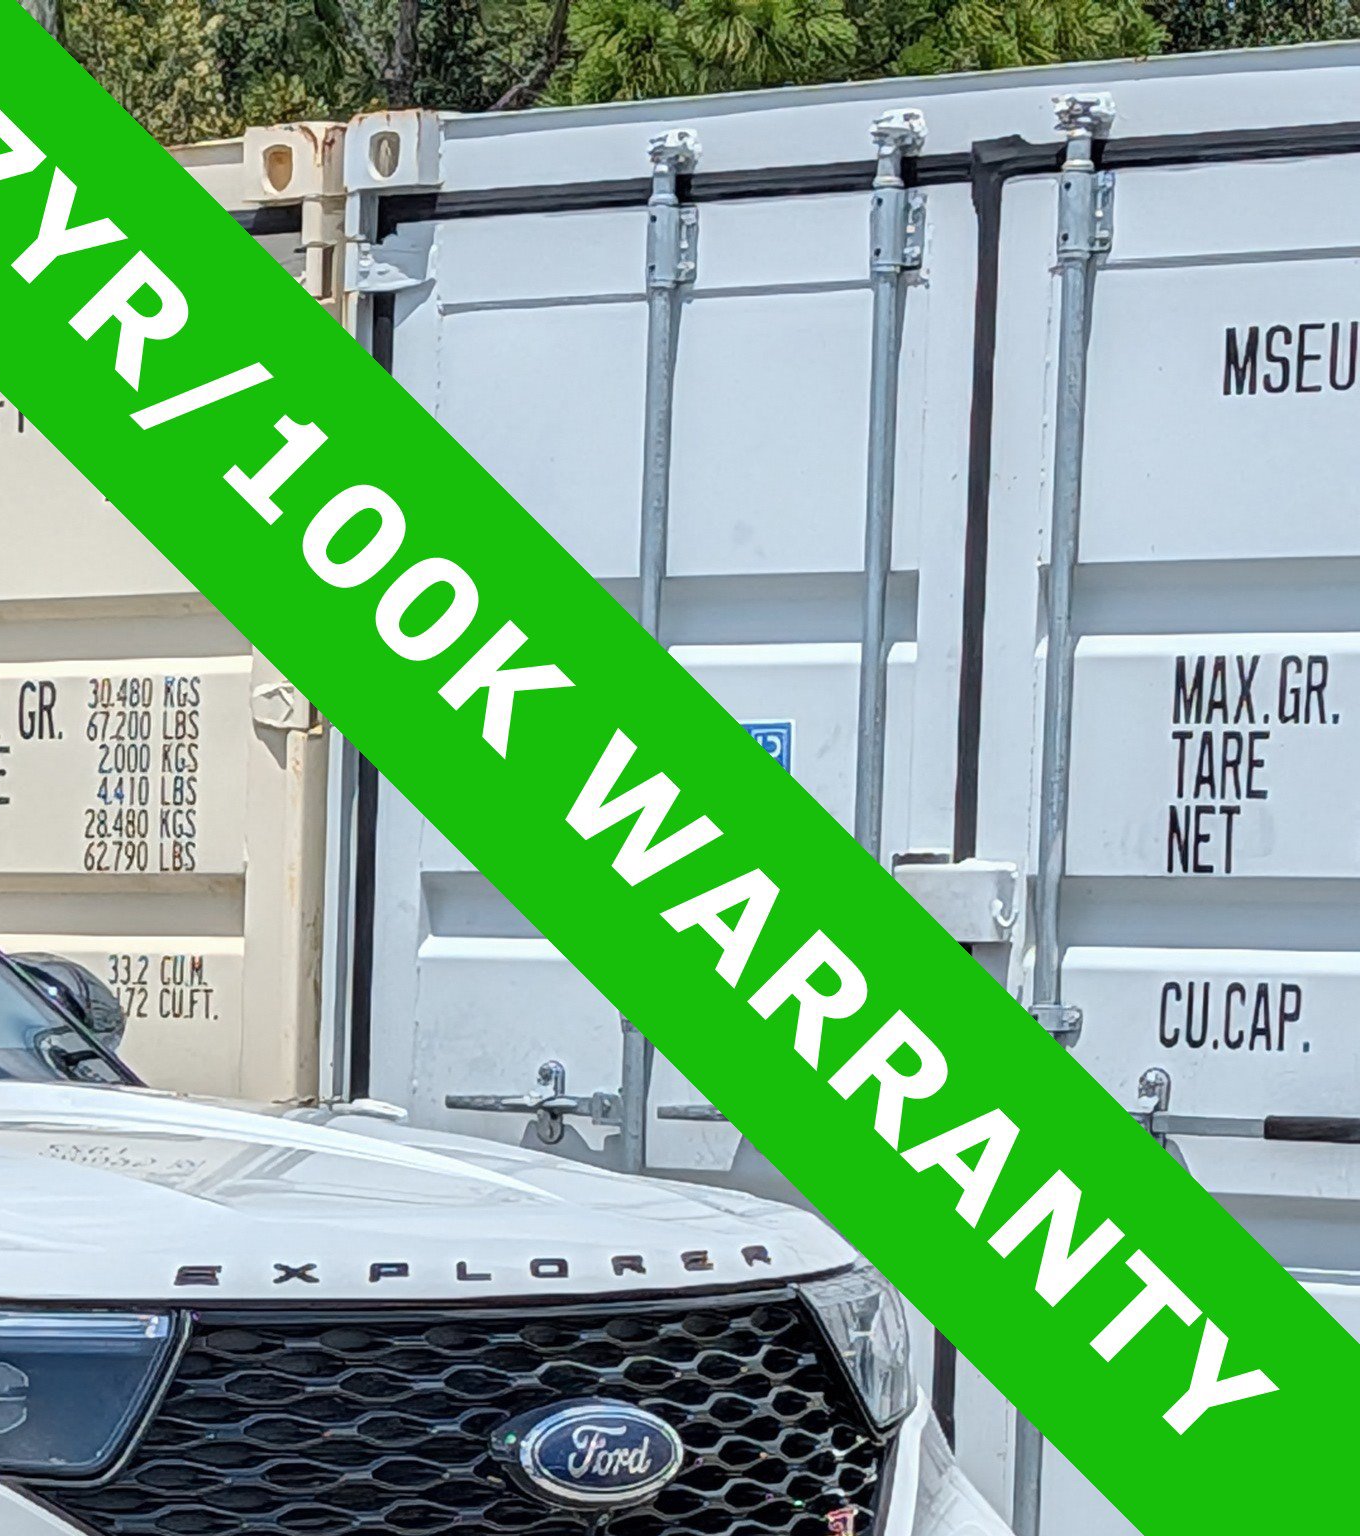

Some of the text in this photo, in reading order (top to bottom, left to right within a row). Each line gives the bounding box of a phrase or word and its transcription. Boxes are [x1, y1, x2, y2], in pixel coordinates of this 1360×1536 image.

[1223, 321, 1359, 395] MSEU
[18, 681, 63, 740] GR.
[163, 676, 201, 707] KGS
[162, 710, 199, 740] LBS
[161, 743, 198, 773] KGS
[1171, 731, 1270, 800] TARE
[160, 775, 197, 806] LBS
[159, 808, 196, 838] KGS
[1167, 805, 1241, 874] NET
[159, 840, 196, 871] LBS
[1159, 981, 1310, 1053] CU.CAP.
[174, 1244, 772, 1286] EXPLORER
[567, 1424, 653, 1479] Ford
